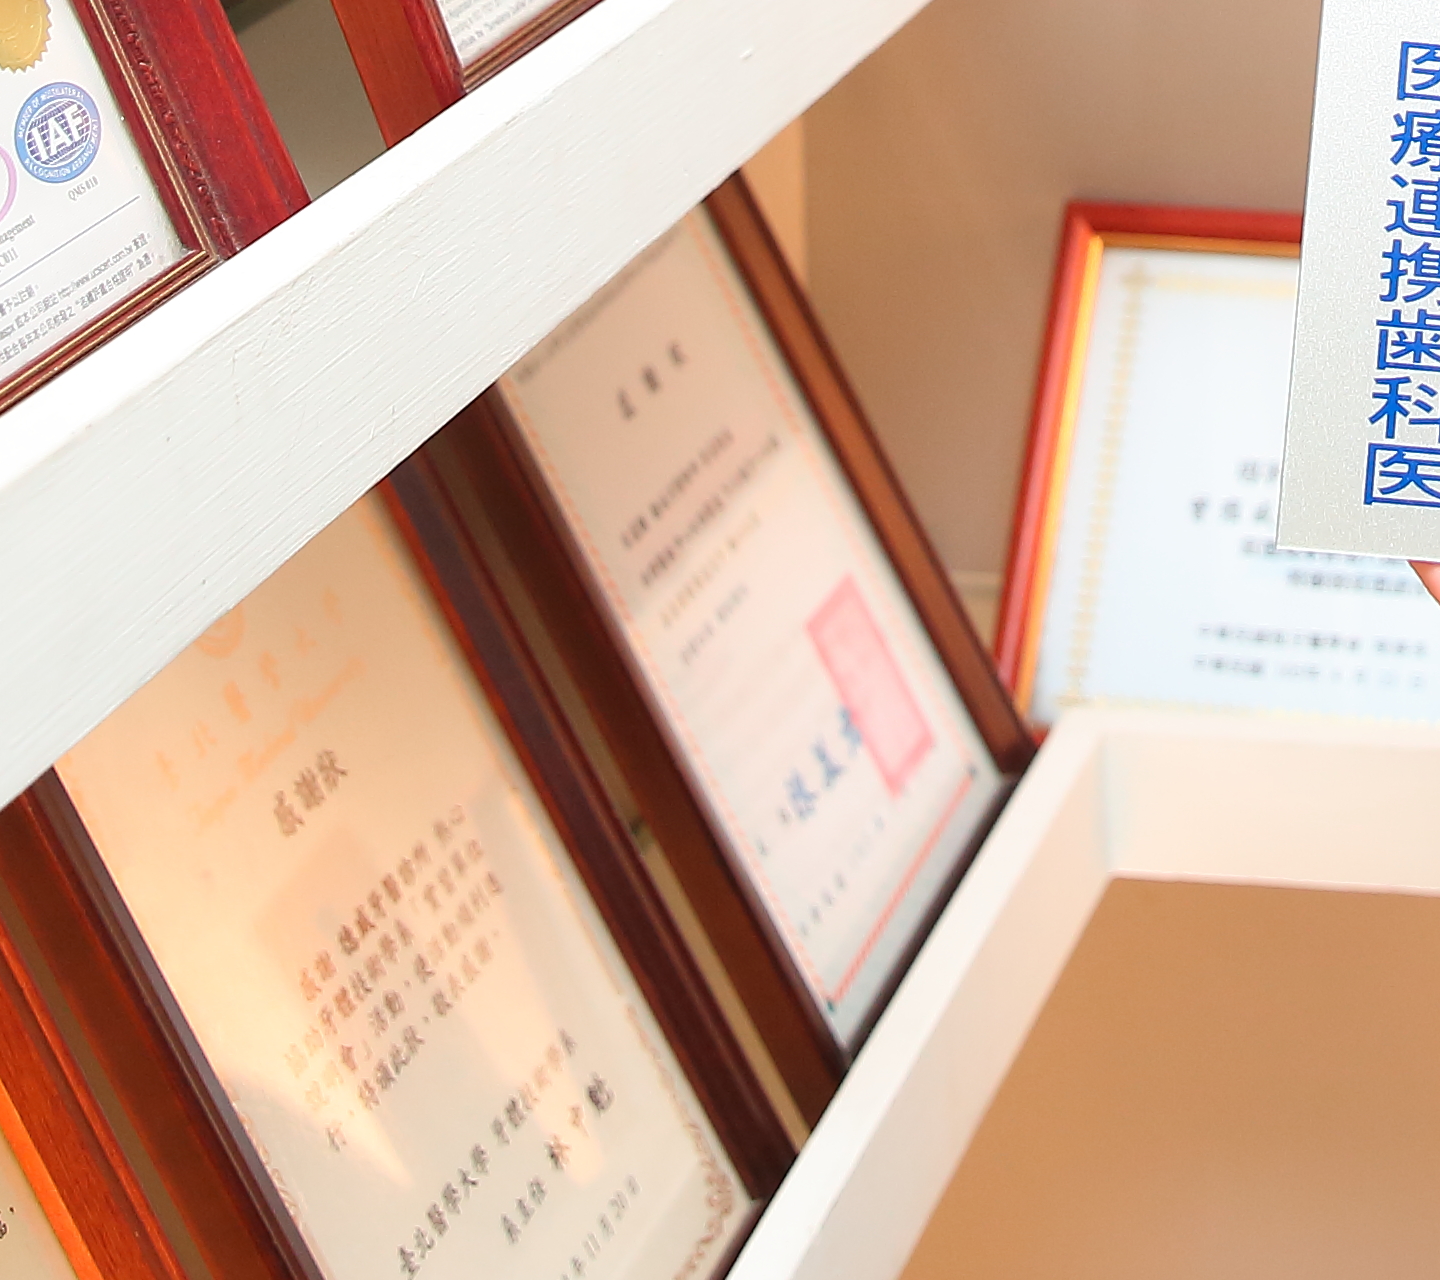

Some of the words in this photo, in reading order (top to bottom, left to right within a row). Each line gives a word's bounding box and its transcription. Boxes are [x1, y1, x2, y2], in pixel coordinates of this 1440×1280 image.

[29, 103, 86, 163] IAF
[273, 748, 349, 837] 感謝狀
